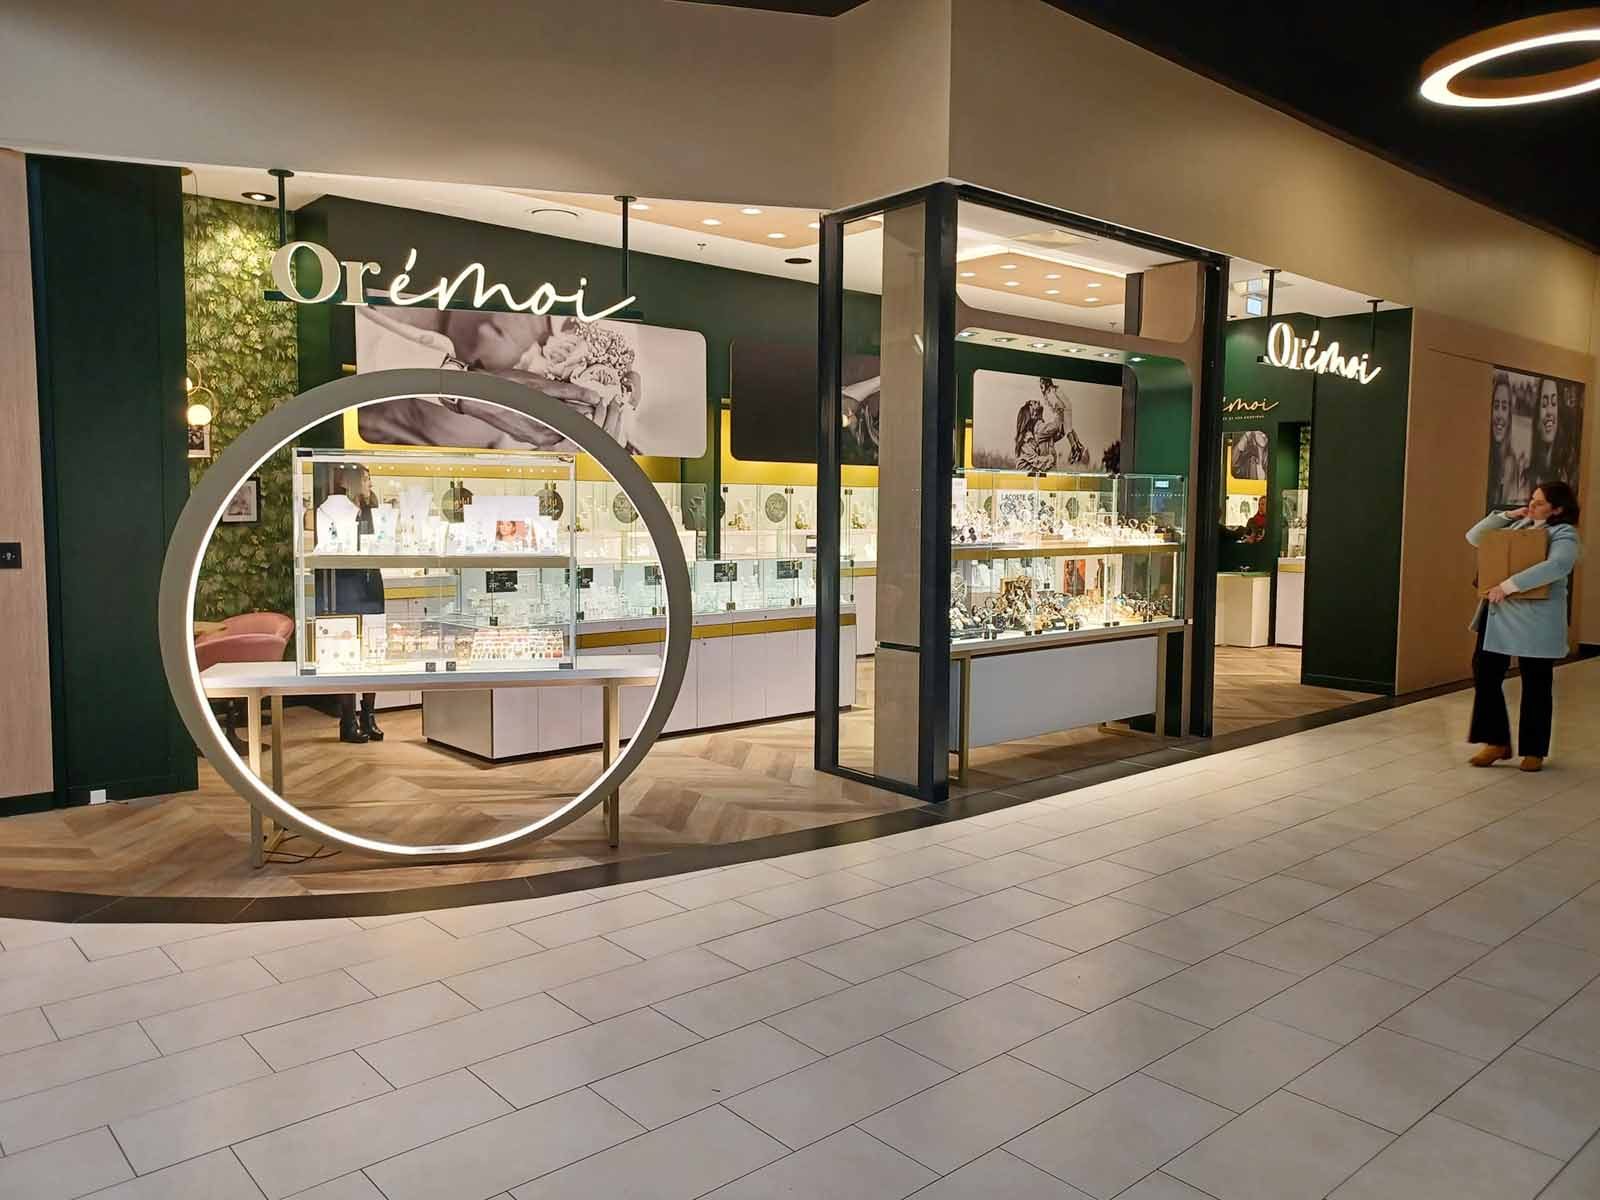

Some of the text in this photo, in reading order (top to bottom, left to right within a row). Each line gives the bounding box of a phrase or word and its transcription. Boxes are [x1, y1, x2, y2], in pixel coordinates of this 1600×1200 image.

[271, 241, 636, 322] Orémoi
[1267, 322, 1382, 385] Orémoi
[1222, 396, 1280, 412] moi
